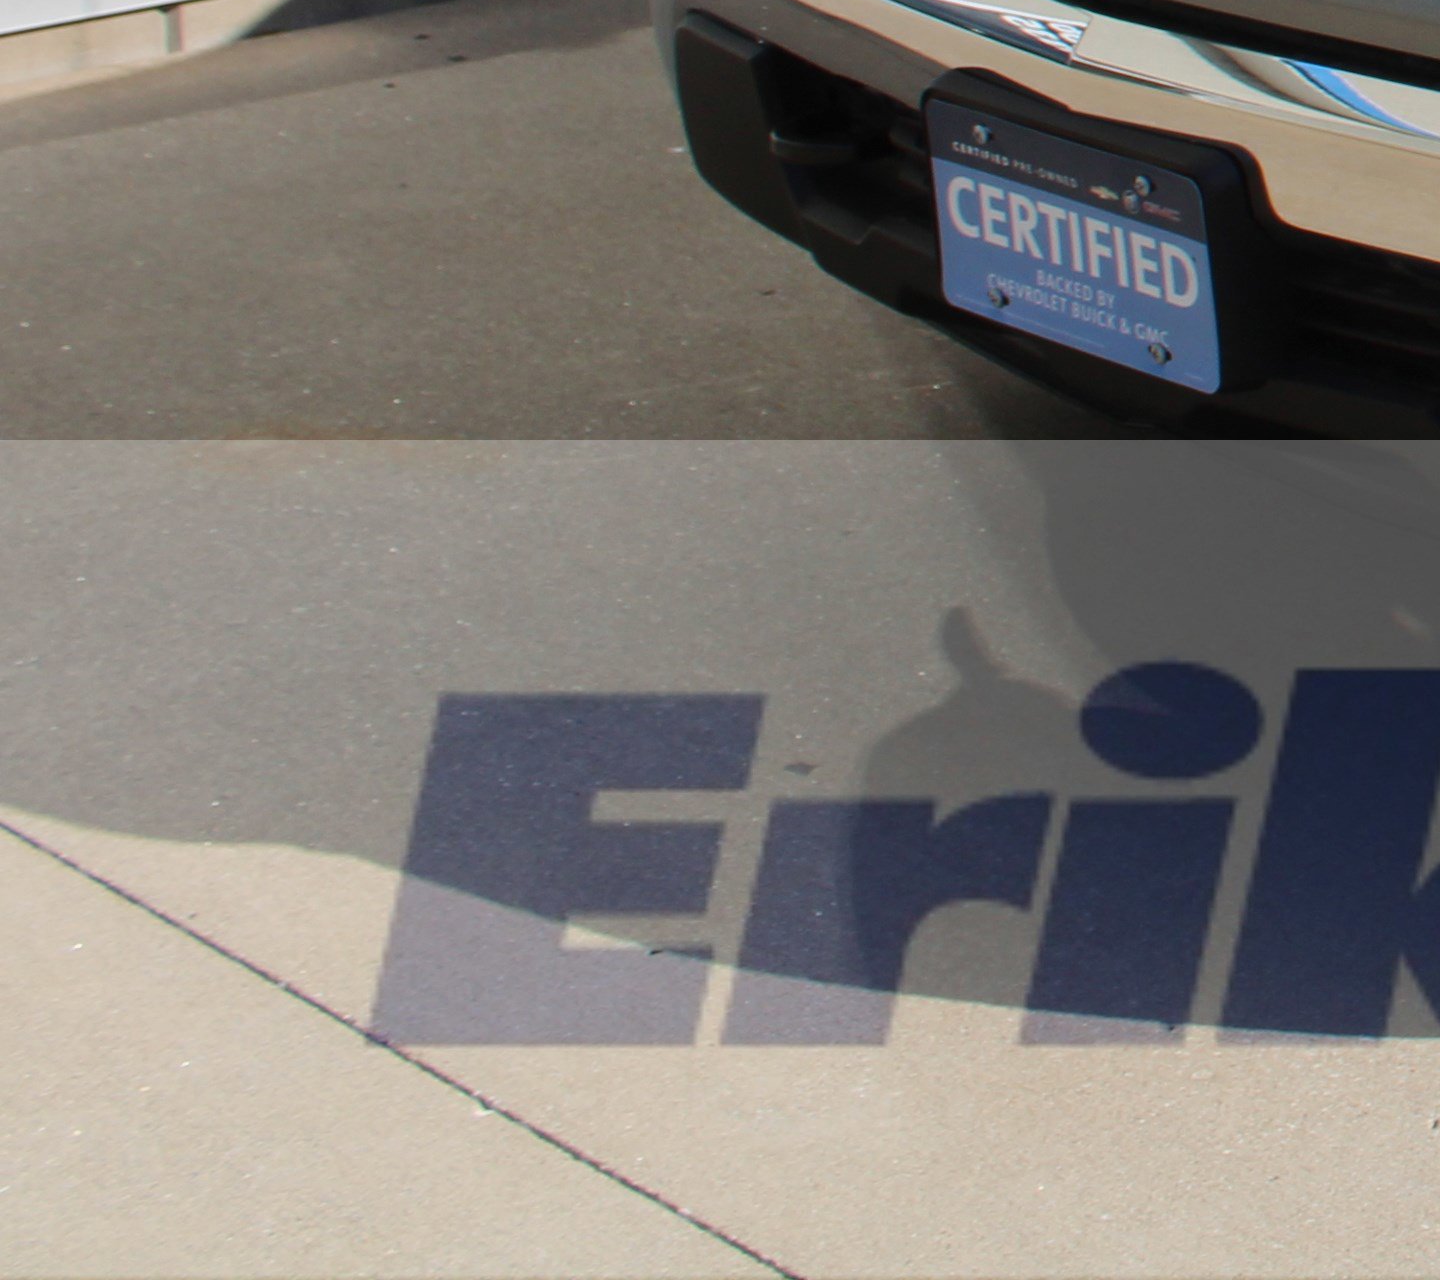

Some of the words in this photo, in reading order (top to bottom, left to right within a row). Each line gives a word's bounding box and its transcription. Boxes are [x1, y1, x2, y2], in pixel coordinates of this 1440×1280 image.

[952, 140, 1010, 168] CERTIFIED
[947, 176, 1199, 308] CERTIFIED
[986, 273, 1068, 313] CHEVROLET
[1071, 301, 1116, 330] BUICK
[1119, 317, 1131, 336] &
[1135, 322, 1169, 344] GMC
[1036, 269, 1092, 301] BACKED
[1097, 289, 1116, 308] BY
